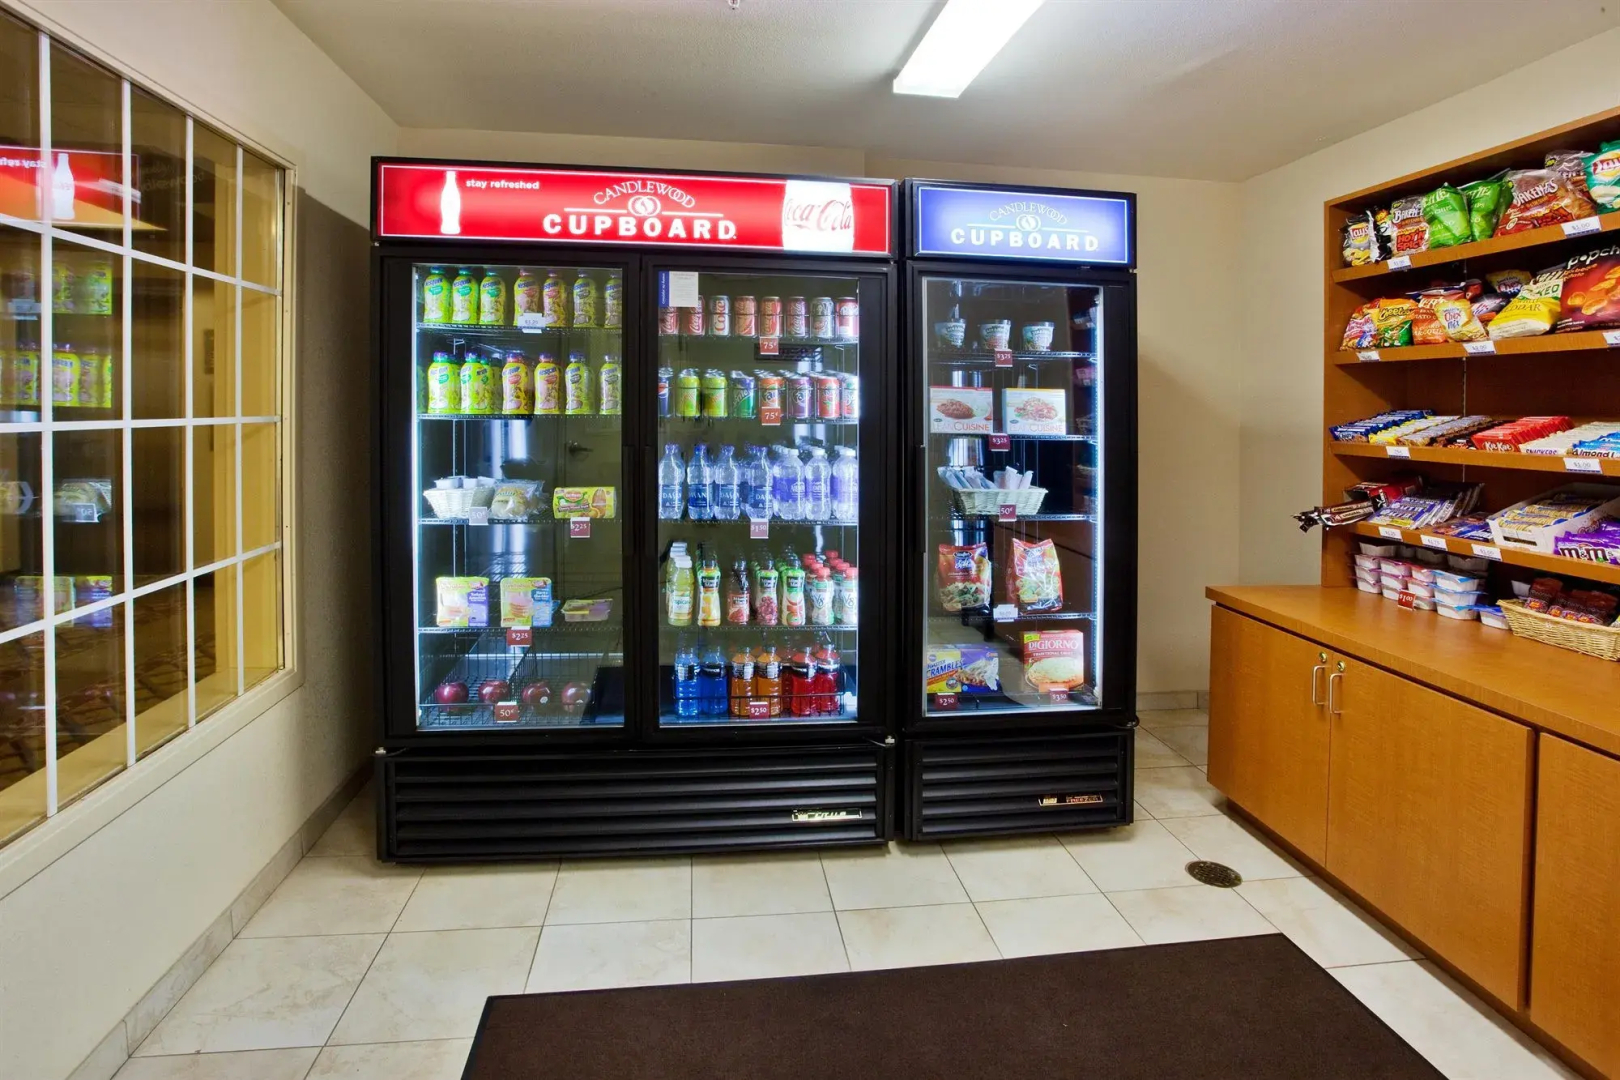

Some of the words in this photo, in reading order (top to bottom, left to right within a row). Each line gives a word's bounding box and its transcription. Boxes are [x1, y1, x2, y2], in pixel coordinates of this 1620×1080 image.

[466, 179, 487, 188] stay
[490, 180, 540, 190] refreshed
[593, 180, 695, 208] CANDLEWOOD
[989, 201, 1067, 225] CANDLEWOOD
[543, 213, 736, 239] CUPBOARD
[950, 228, 1099, 251] CUPBOARD
[715, 301, 726, 331] Coke
[954, 421, 989, 432] CUISINE
